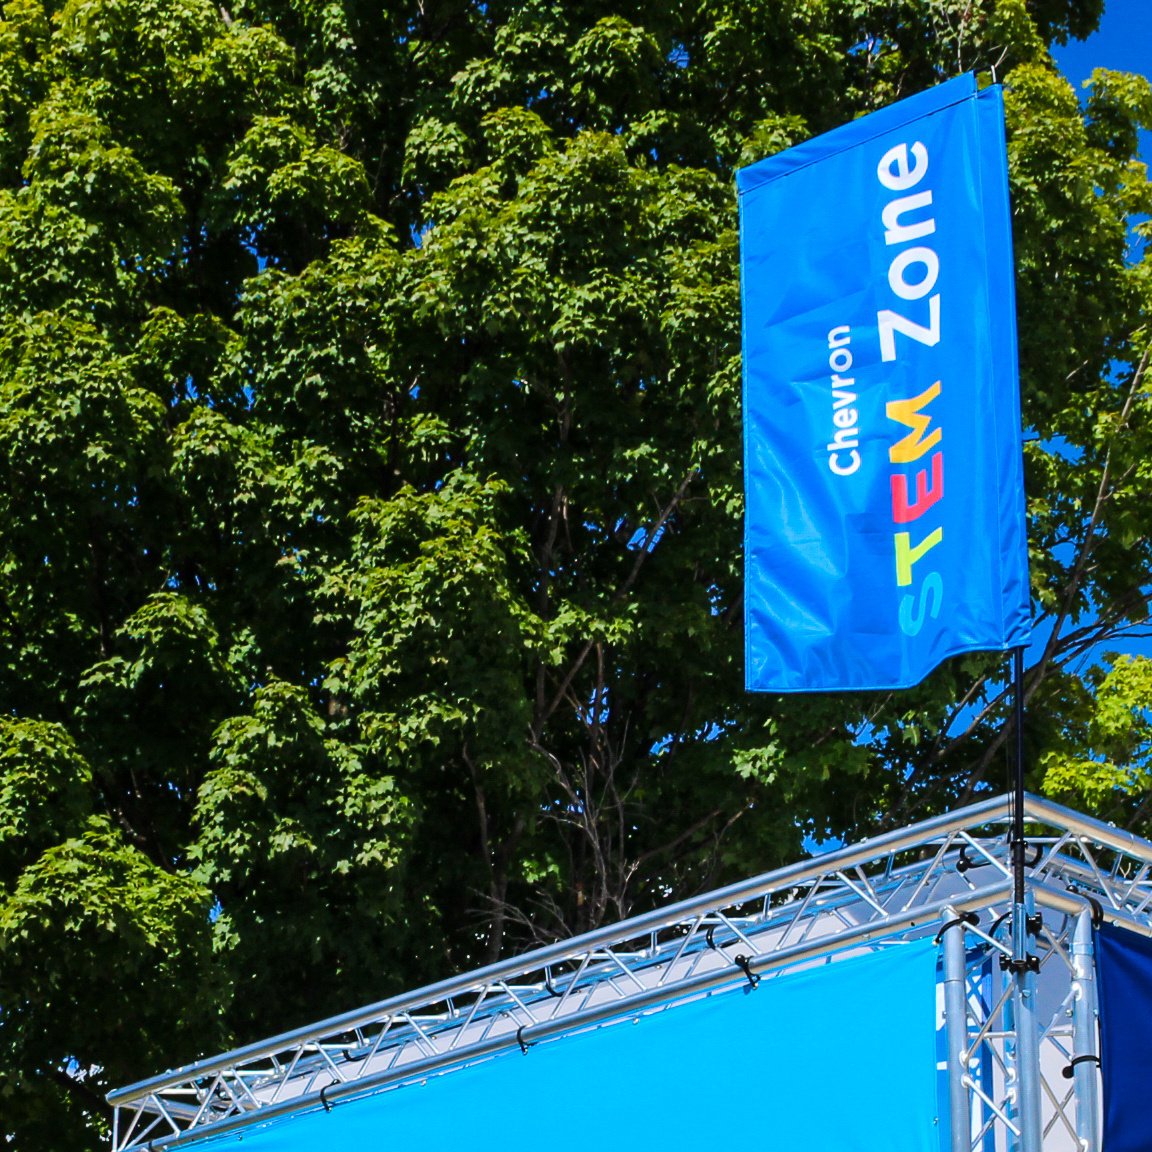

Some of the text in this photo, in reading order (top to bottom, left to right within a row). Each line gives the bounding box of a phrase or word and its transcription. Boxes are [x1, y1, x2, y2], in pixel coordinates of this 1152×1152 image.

[828, 324, 860, 476] Chevron
[877, 140, 944, 637] STEM Zone
